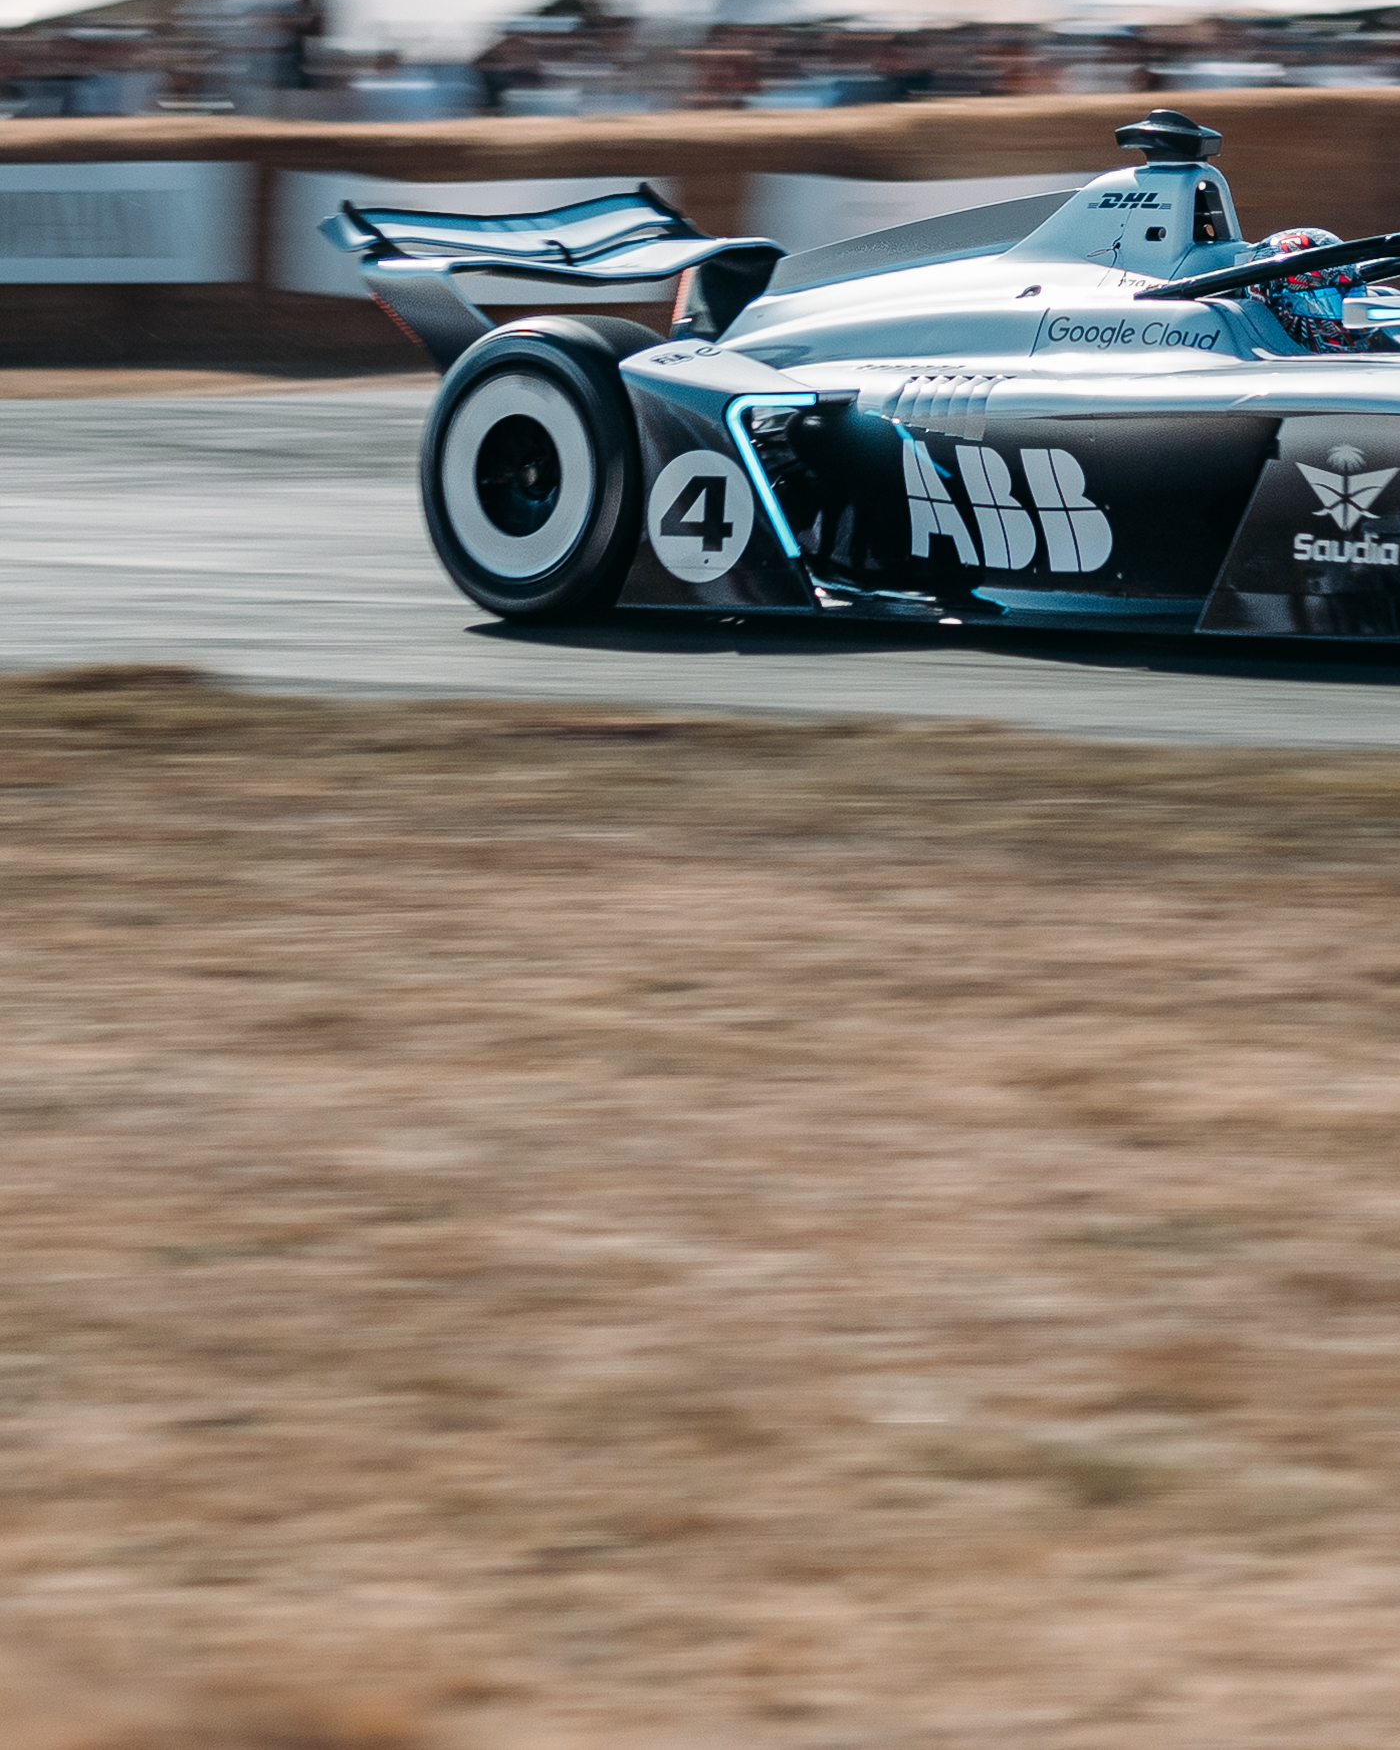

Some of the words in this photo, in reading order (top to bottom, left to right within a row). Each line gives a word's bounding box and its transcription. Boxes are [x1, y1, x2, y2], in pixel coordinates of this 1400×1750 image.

[1098, 192, 1161, 210] DHL
[1048, 316, 1135, 350] Google
[1141, 322, 1221, 351] Cloud
[660, 475, 734, 552] 4
[902, 439, 1113, 572] ABB
[1293, 532, 1399, 566] Saudia
